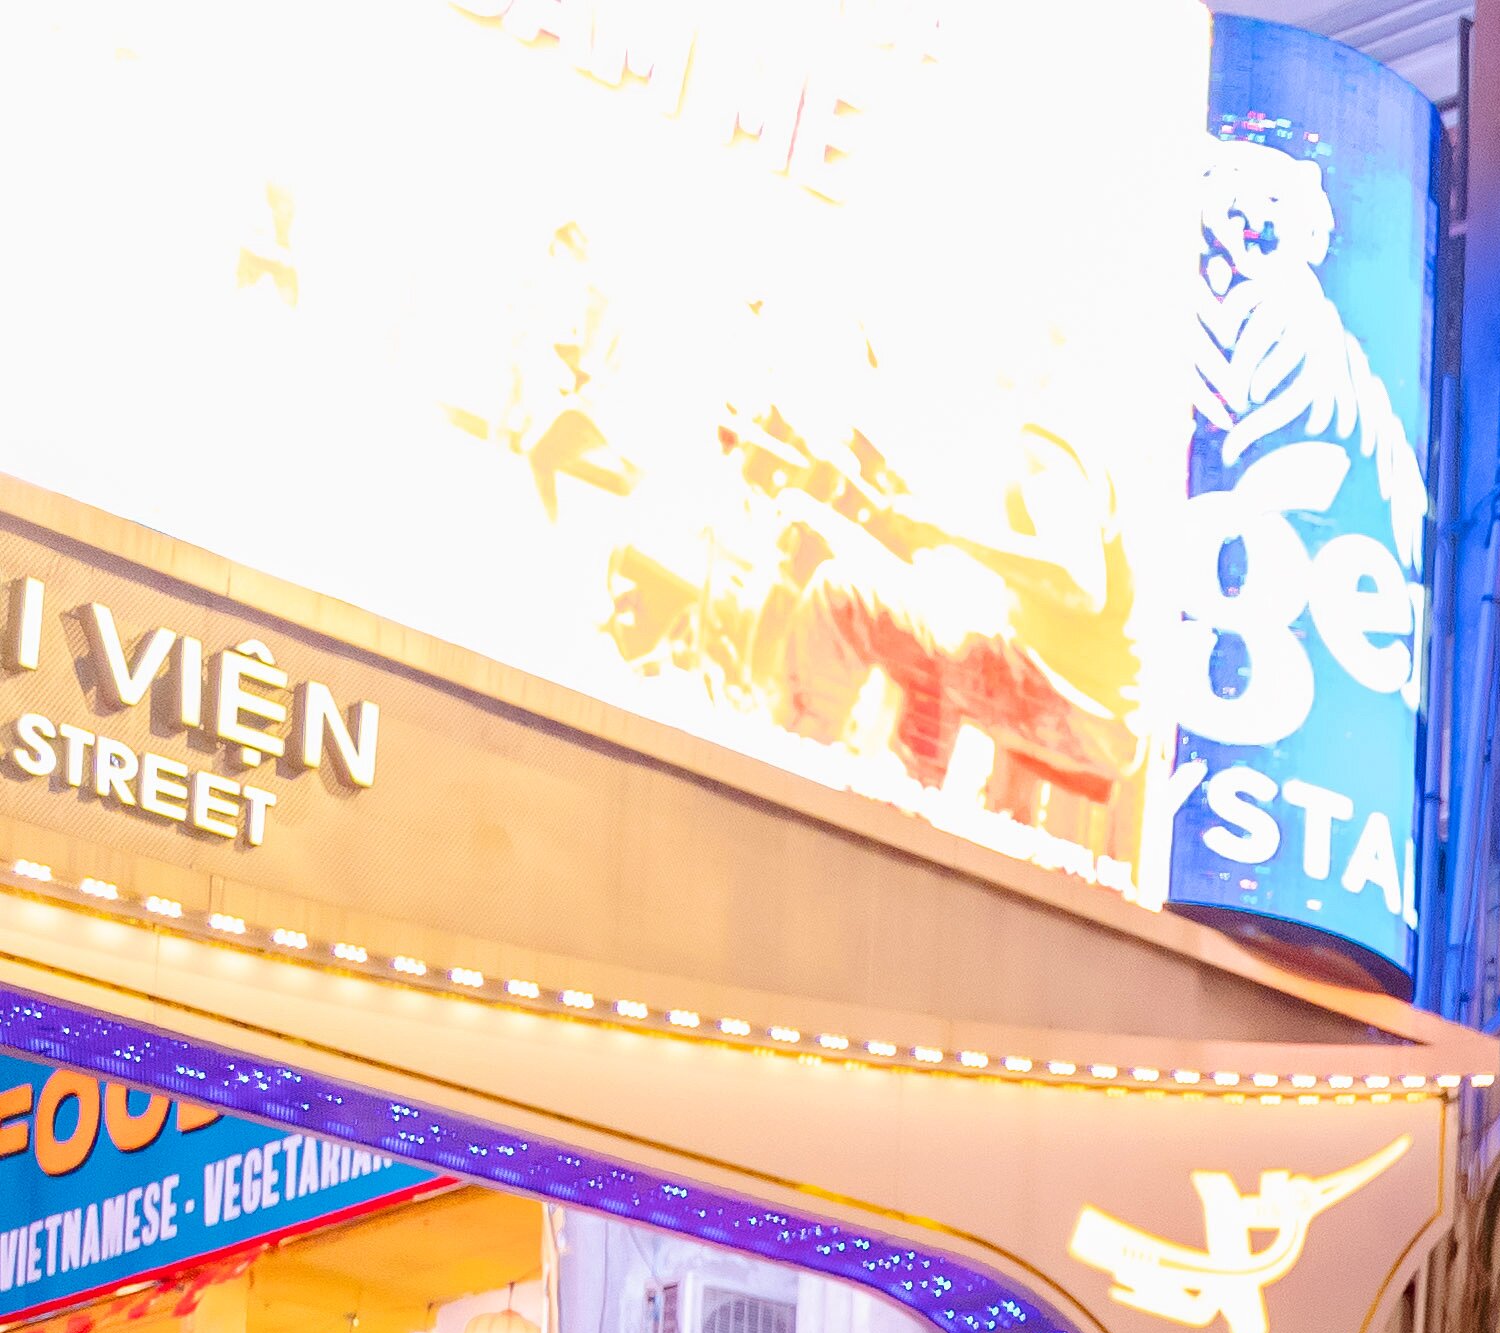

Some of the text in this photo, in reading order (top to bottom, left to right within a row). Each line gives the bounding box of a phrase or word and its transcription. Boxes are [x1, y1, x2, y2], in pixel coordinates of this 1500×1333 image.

[92, 601, 381, 788] VIỆN
[13, 712, 278, 846] STREET
[0, 1173, 181, 1292] VIETNAMESE
